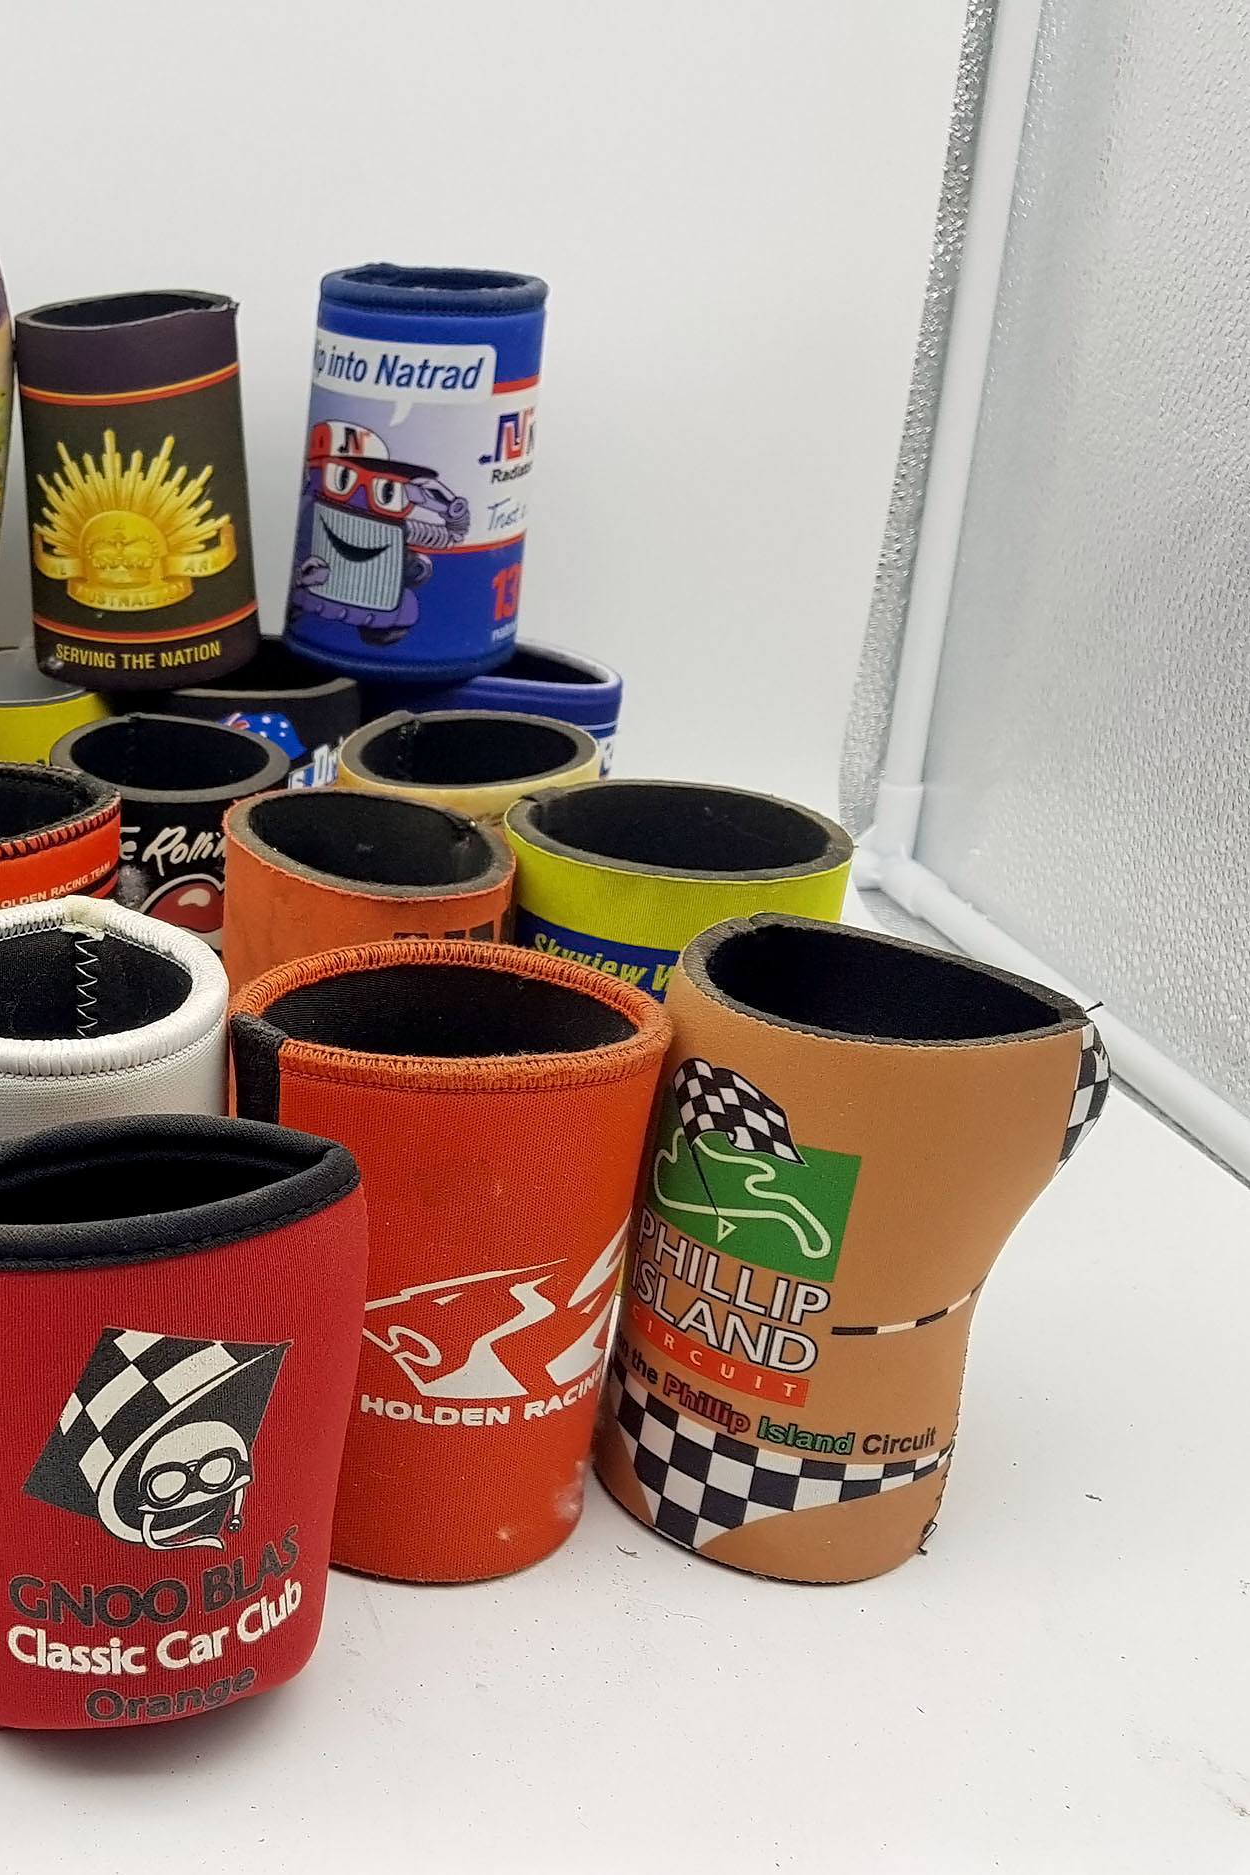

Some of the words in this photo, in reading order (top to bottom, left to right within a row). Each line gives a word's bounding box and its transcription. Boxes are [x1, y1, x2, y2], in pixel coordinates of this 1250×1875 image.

[328, 345, 367, 383] into
[374, 353, 485, 389] Natrad
[55, 643, 116, 669] SERVING
[122, 654, 156, 670] THE
[160, 640, 222, 669] NATION
[50, 874, 88, 898] RACING
[89, 861, 111, 881] TEAM
[631, 1250, 818, 1374] ISLAND
[637, 1206, 831, 1326] PHILLIP
[631, 1304, 798, 1398] CIRCUIT
[360, 1394, 511, 1427] HOLDEN
[632, 1348, 658, 1385] the
[662, 1372, 751, 1435] Phillip
[758, 1416, 856, 1456] Island
[862, 1426, 937, 1456] Circuit
[8, 1574, 191, 1629] GNOO
[201, 1524, 301, 1616] BLAS
[7, 1624, 148, 1676] Classic
[156, 1625, 230, 1672] Car
[236, 1578, 303, 1644] Club
[85, 1666, 257, 1723] Orange
